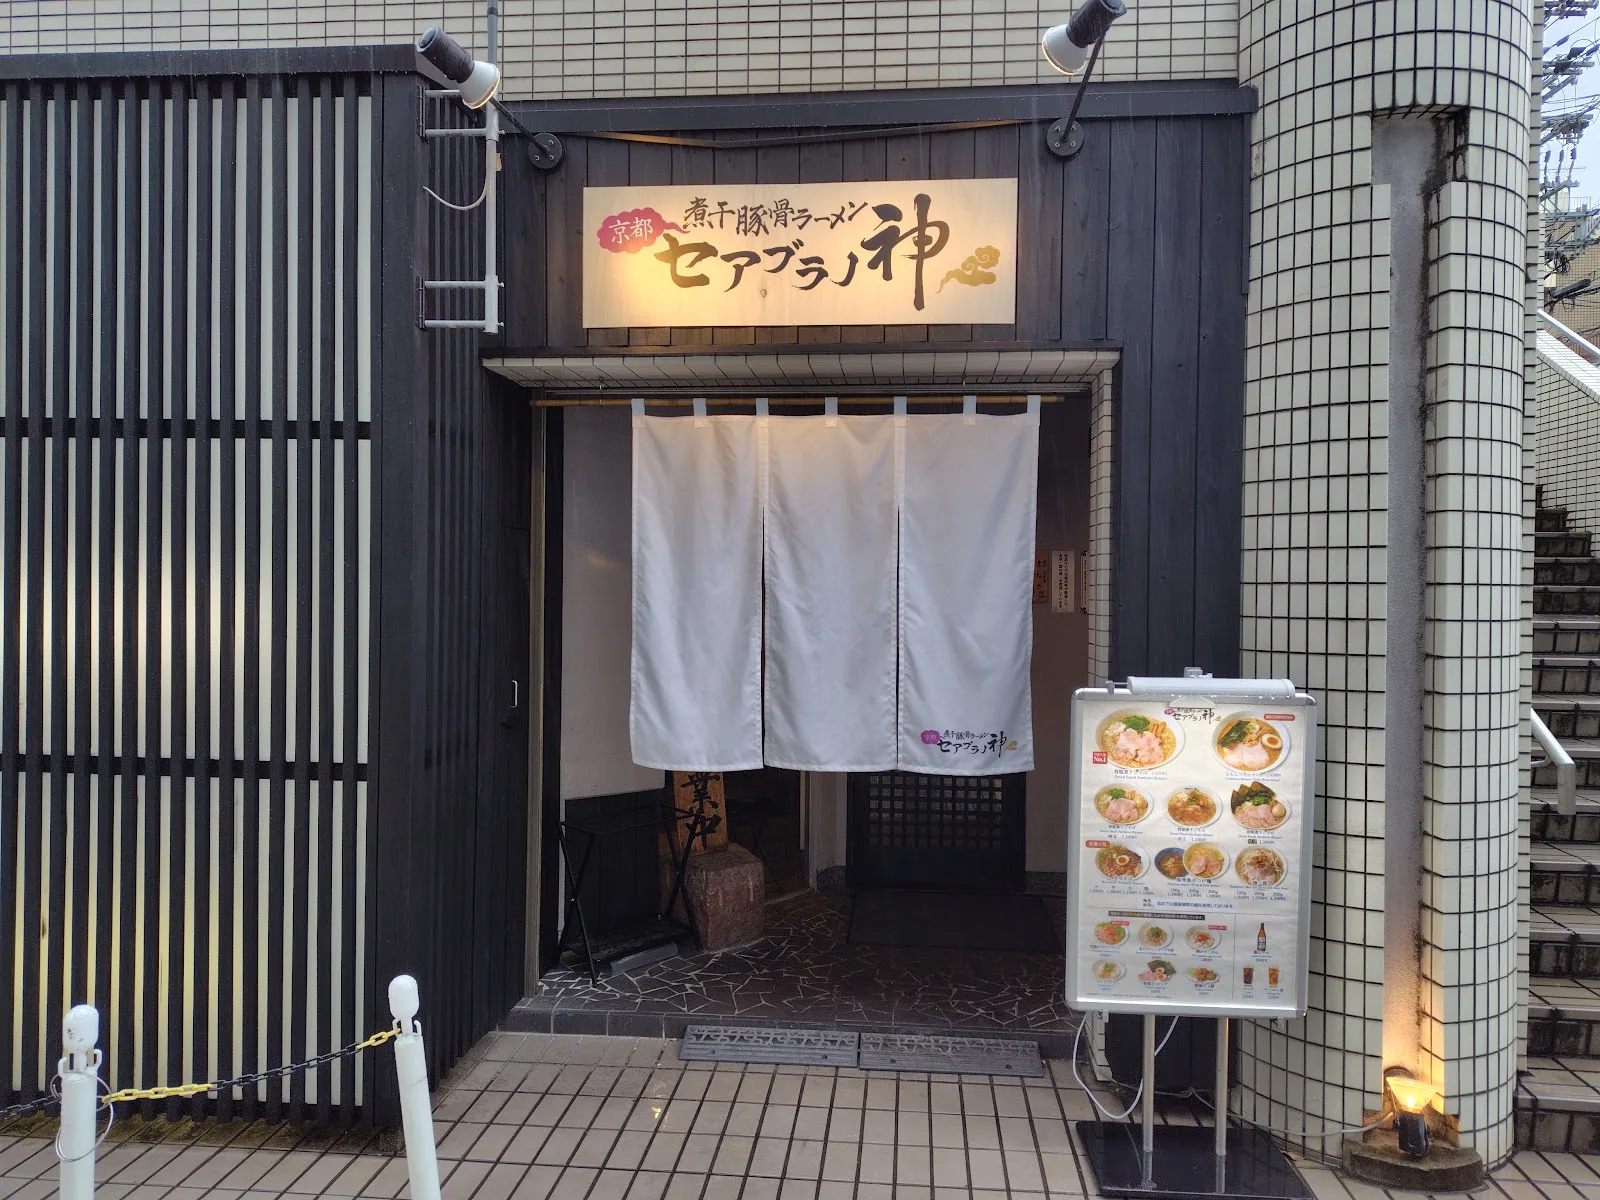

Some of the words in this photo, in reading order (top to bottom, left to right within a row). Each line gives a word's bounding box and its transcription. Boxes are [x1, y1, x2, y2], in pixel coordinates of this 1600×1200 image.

[607, 217, 654, 245] 京都
[682, 196, 869, 237] 煮干豚骨ラーメン
[654, 193, 950, 312] セアブラノ神
[937, 730, 1007, 758] セアブラノ神
